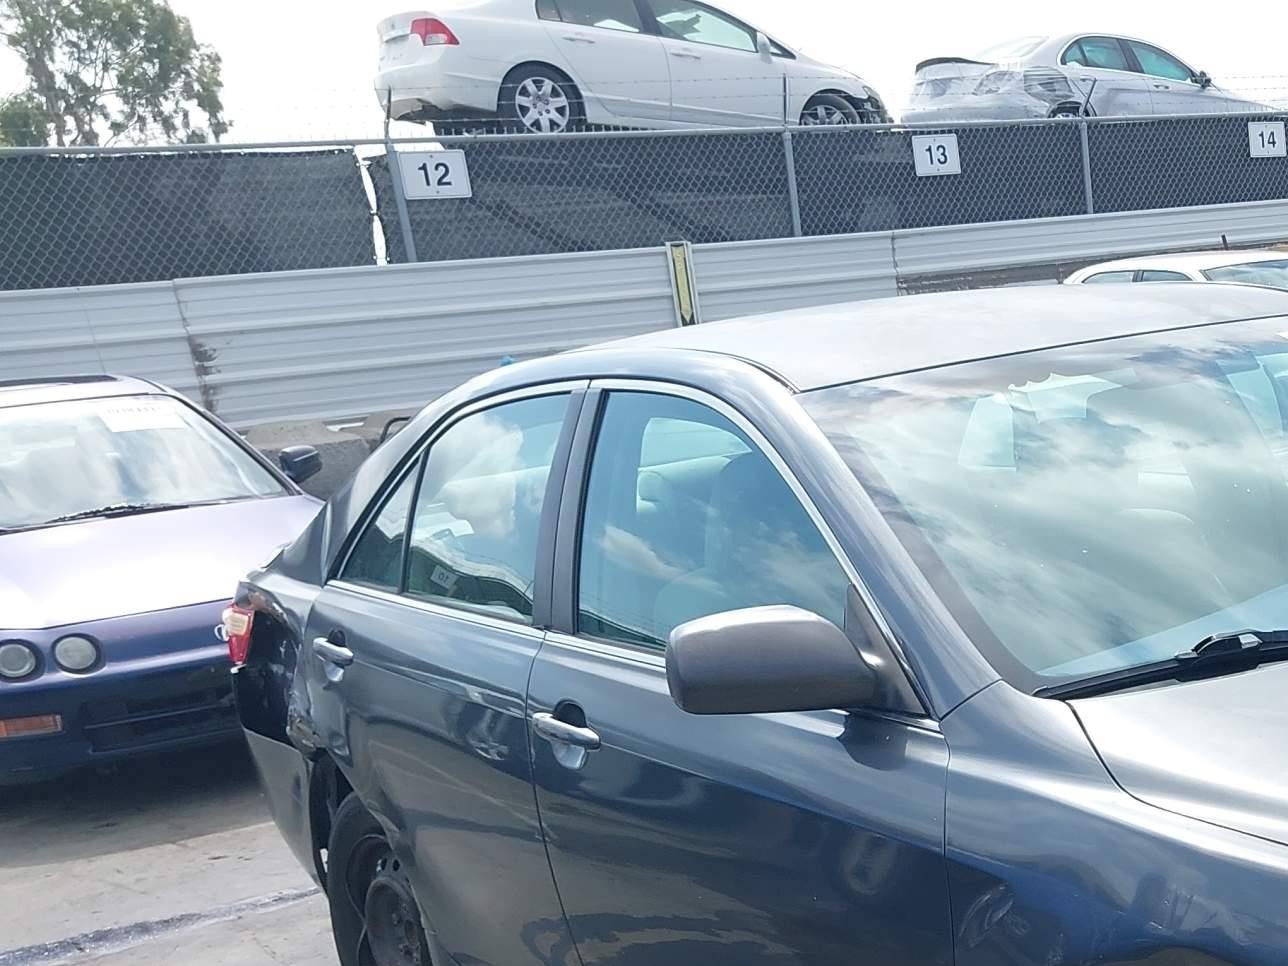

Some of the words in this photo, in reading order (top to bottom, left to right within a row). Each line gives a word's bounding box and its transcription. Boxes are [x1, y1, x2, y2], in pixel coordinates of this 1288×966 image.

[1258, 130, 1277, 149] 14
[925, 144, 948, 165] 13
[417, 162, 453, 187] 12
